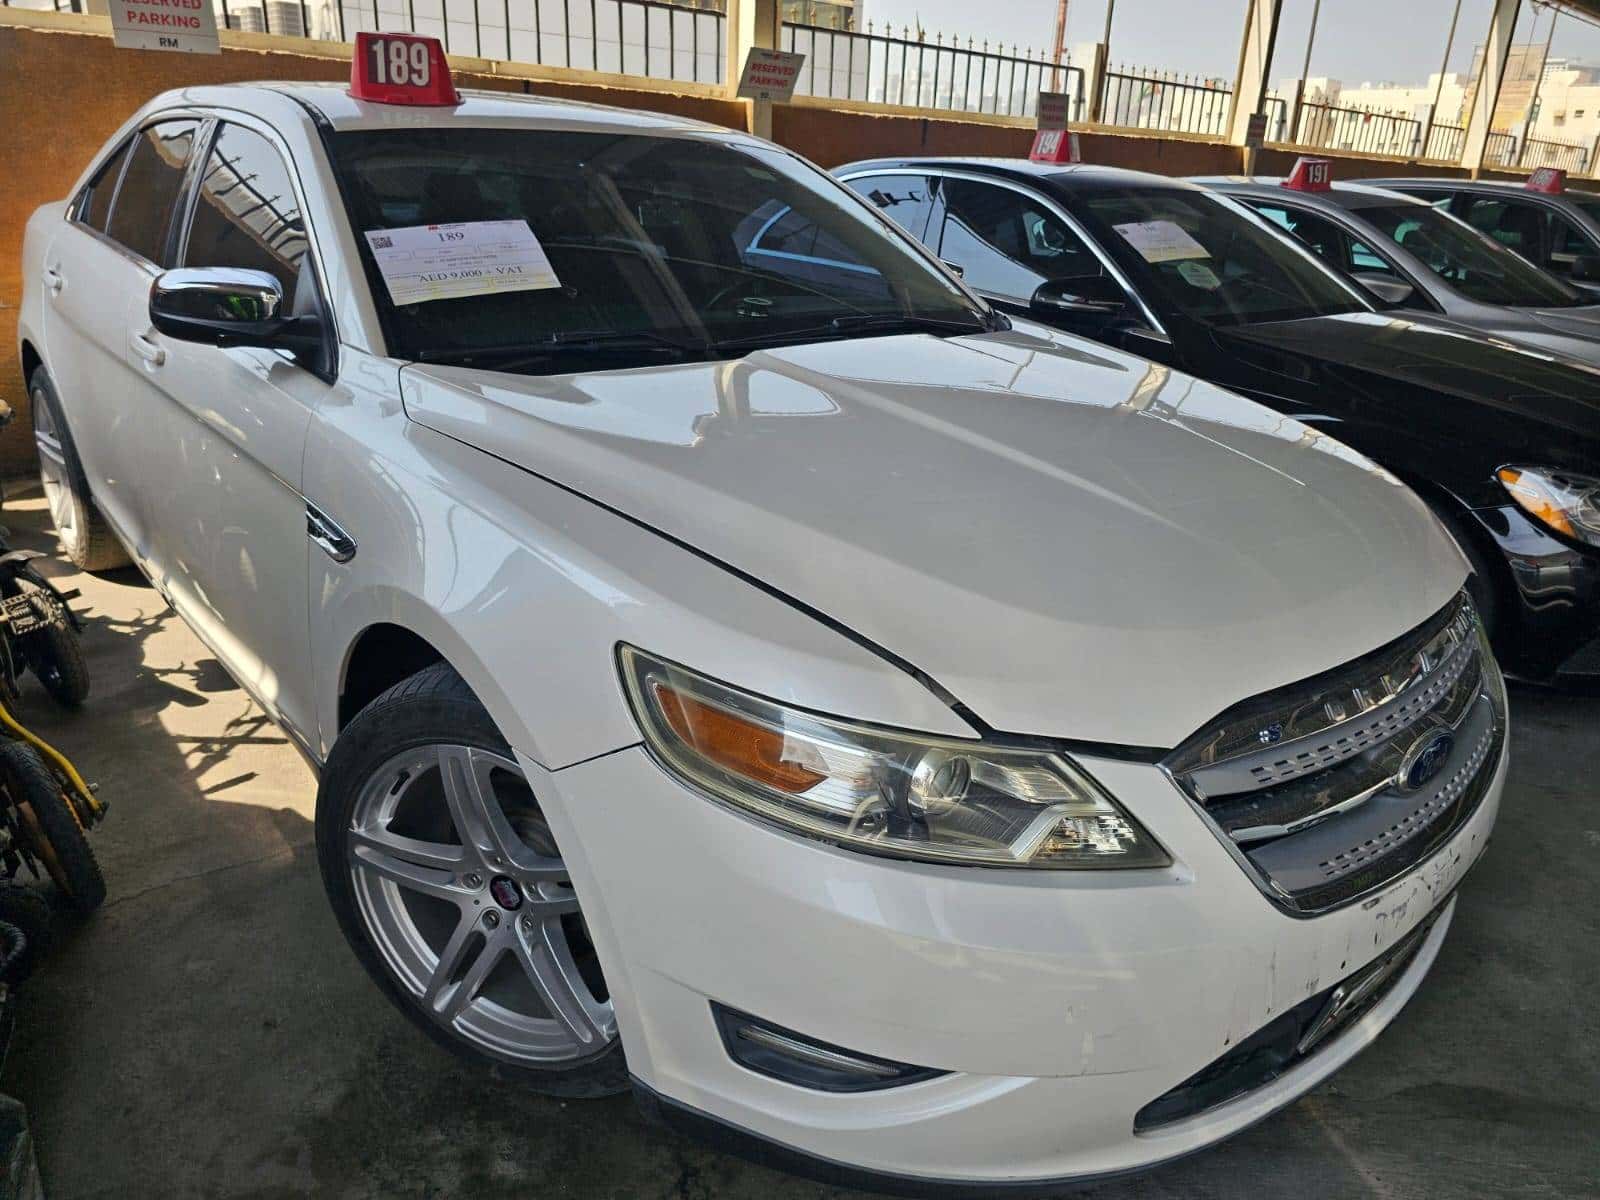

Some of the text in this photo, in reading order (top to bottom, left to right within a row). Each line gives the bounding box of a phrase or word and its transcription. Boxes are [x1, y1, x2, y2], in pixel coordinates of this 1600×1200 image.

[126, 10, 201, 28] PARKING
[158, 37, 179, 49] RM
[371, 39, 430, 86] 189
[1308, 164, 1329, 184] 191
[437, 232, 465, 242] 189
[419, 273, 448, 283] AED
[454, 269, 483, 281] 9,000
[496, 265, 524, 276] VAT
